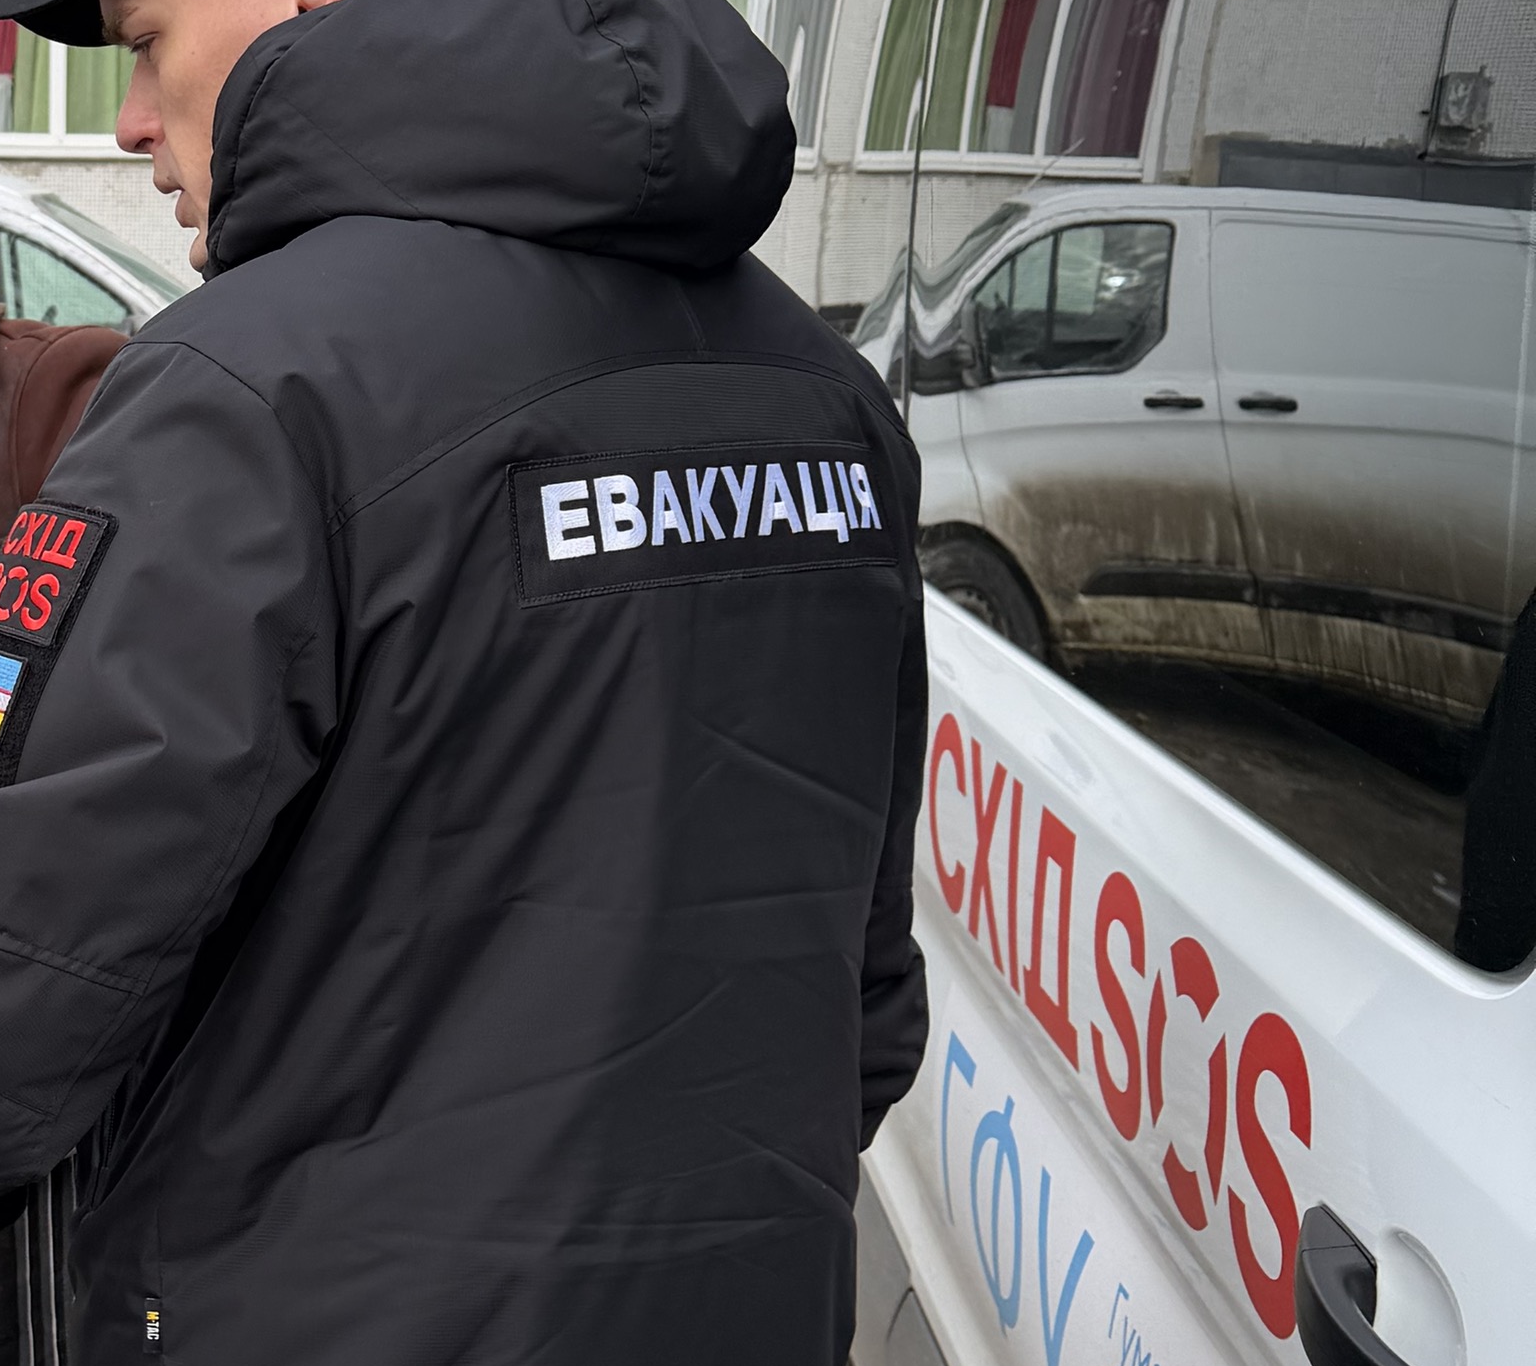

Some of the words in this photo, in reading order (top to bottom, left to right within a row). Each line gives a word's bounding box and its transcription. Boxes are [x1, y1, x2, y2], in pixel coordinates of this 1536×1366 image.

[3, 511, 87, 570] СХІД
[540, 461, 883, 561] ЕВАКУАЦІЯ
[929, 712, 1080, 1074] СХІД
[1091, 871, 1312, 1340] SOS
